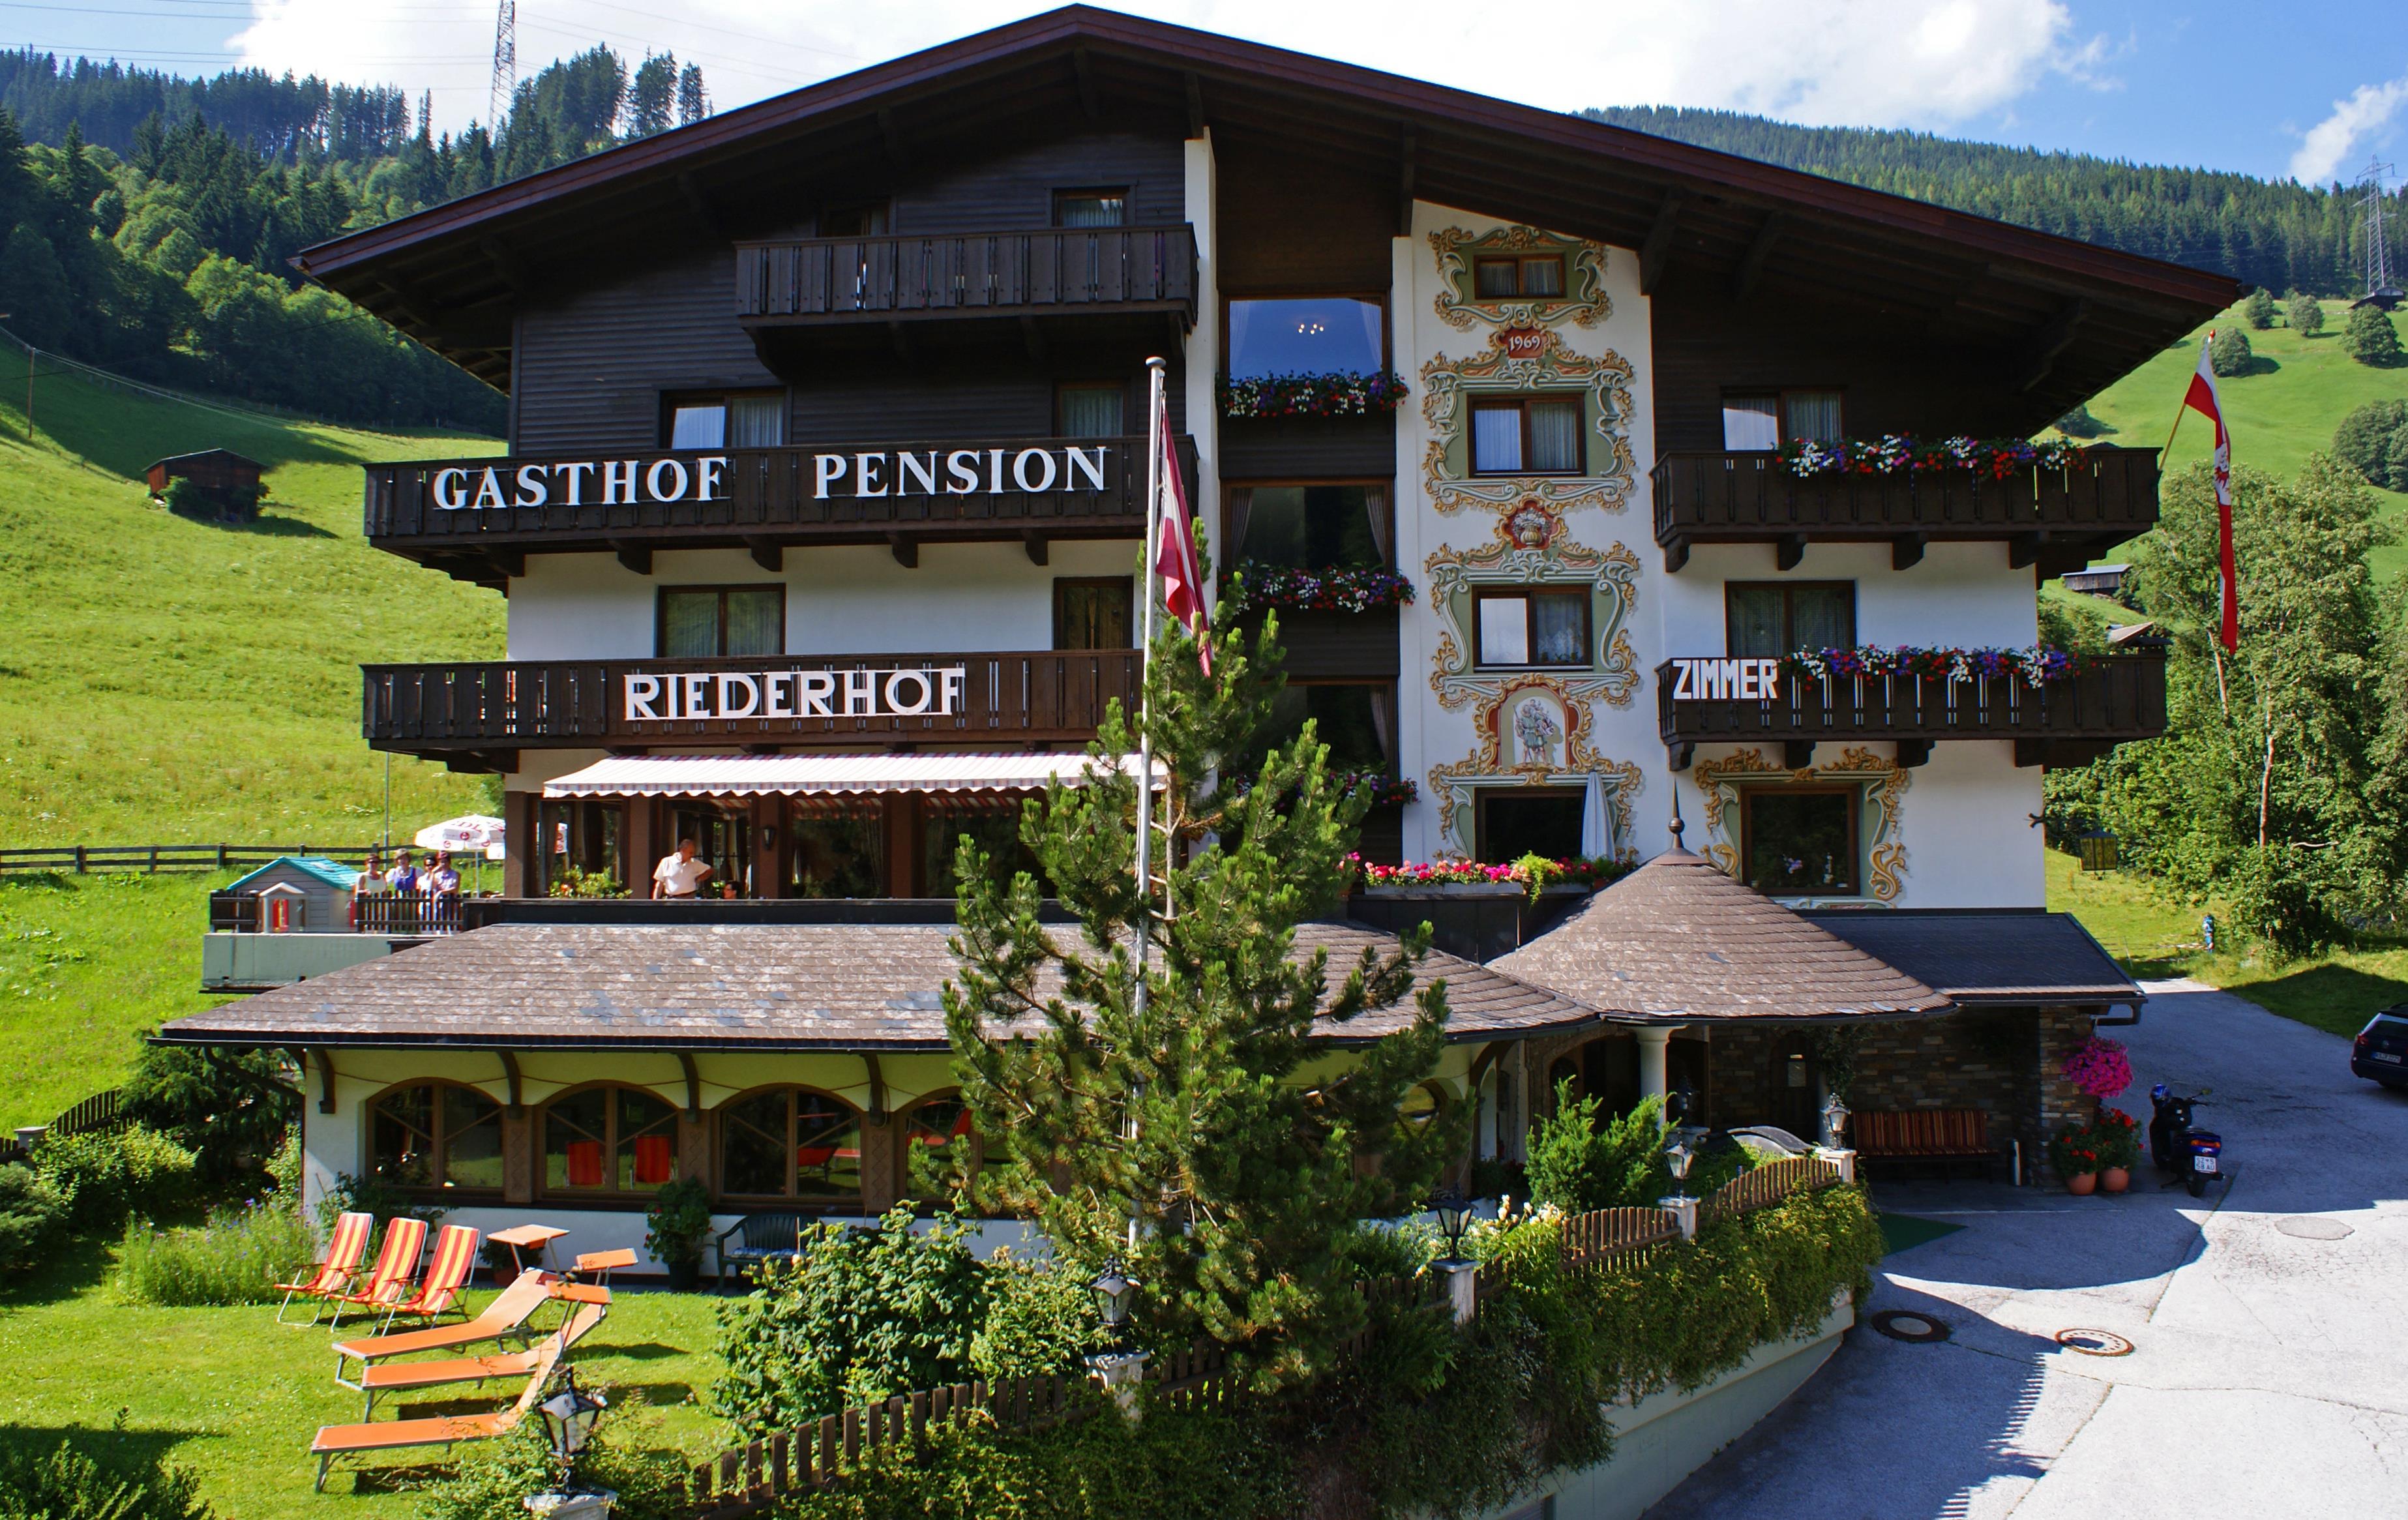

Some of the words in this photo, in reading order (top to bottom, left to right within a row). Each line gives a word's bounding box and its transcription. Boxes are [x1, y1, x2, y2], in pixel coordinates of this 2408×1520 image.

[1508, 334, 1540, 351] 1969
[433, 457, 727, 510] GASTHOF
[814, 446, 1107, 499] PENSION
[624, 668, 966, 720] RIEDERHOF
[1672, 659, 1778, 700] ZIMMER
